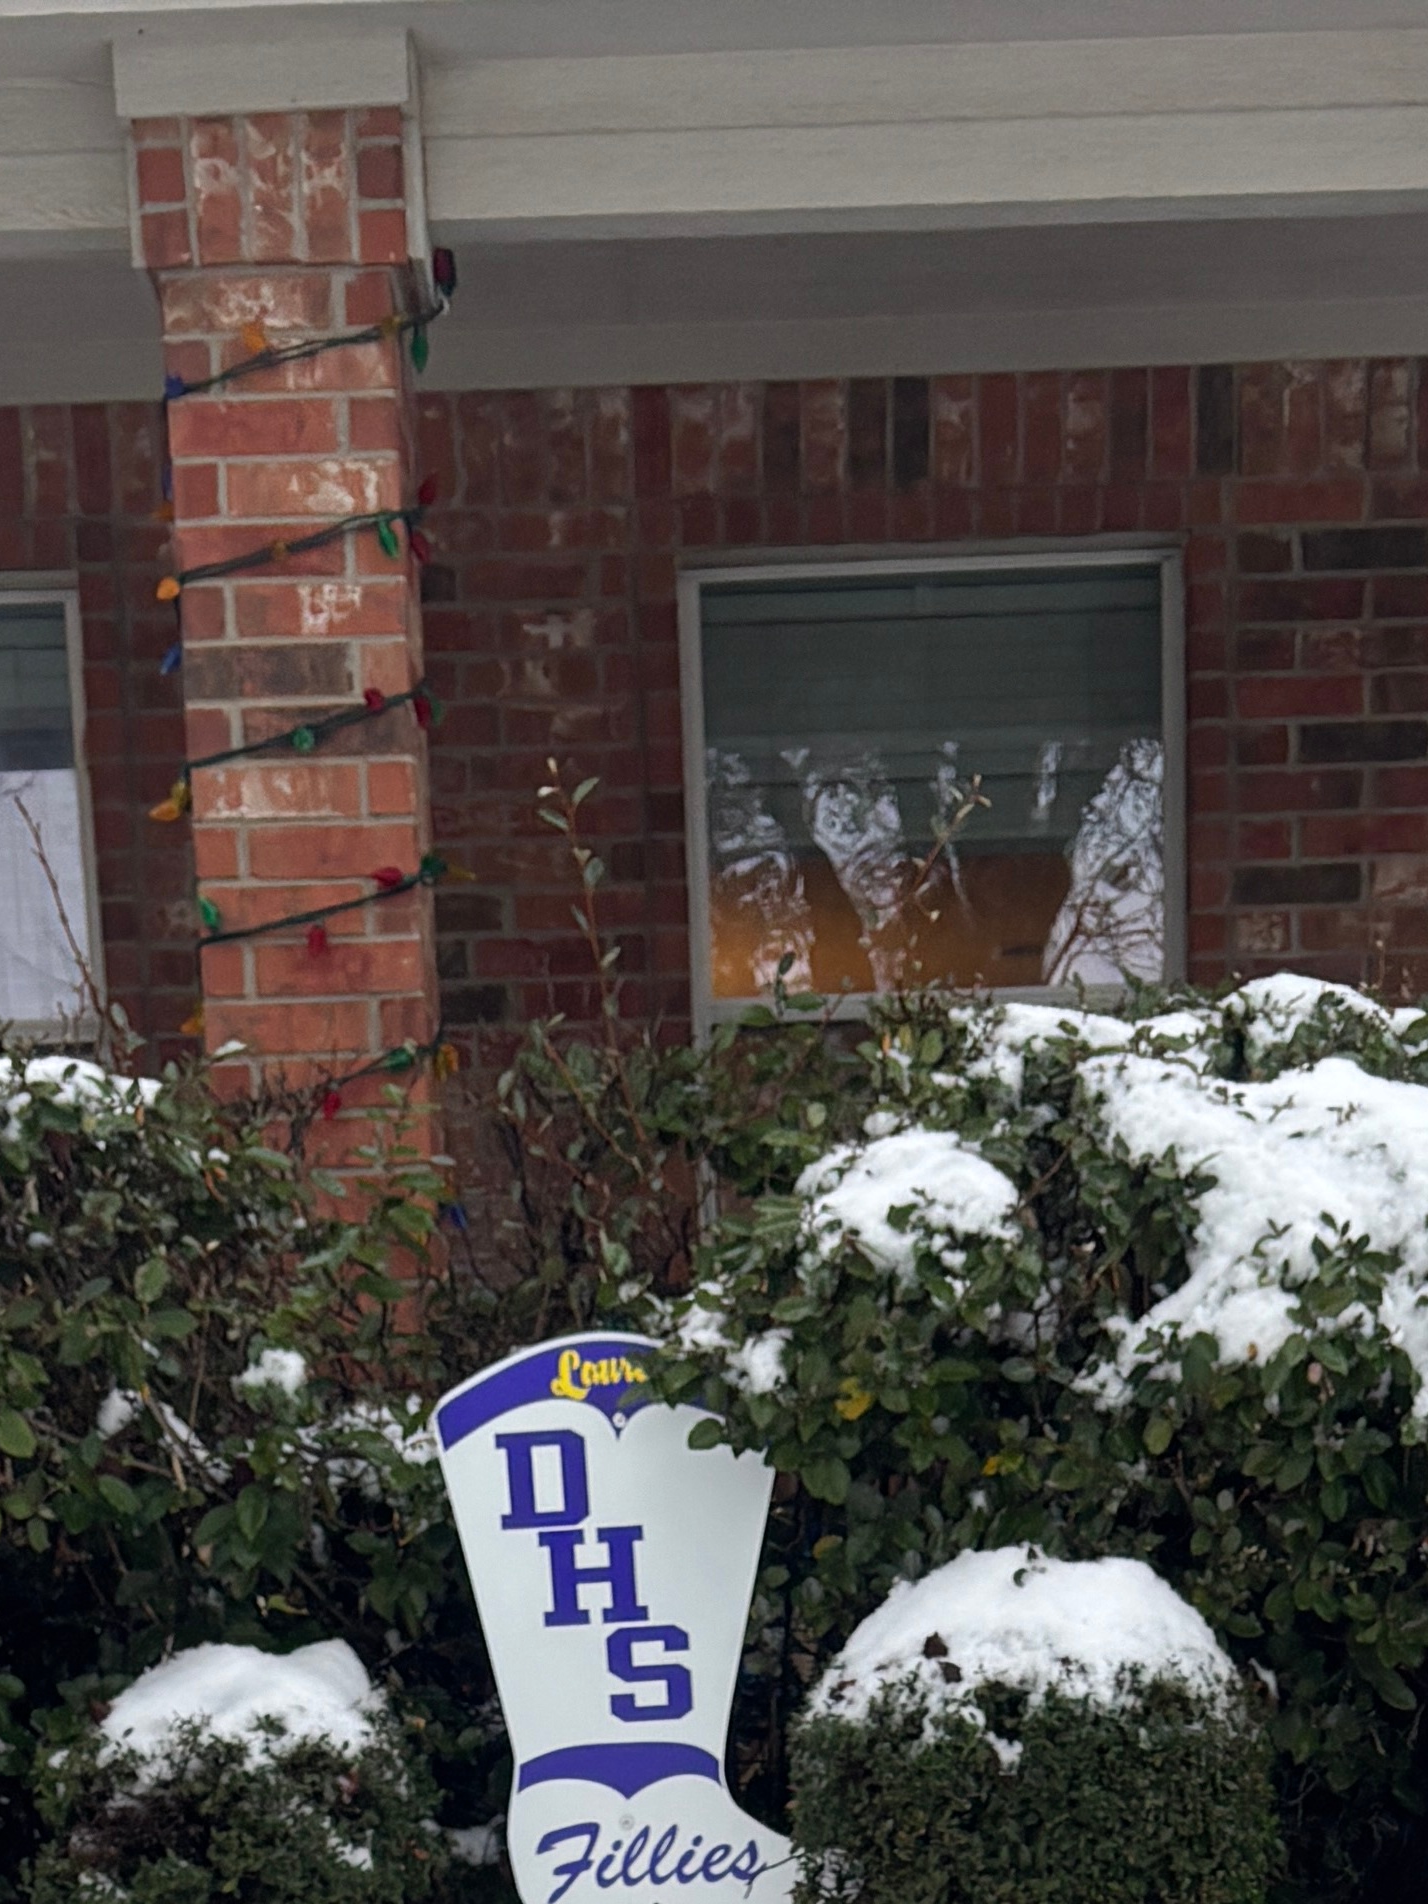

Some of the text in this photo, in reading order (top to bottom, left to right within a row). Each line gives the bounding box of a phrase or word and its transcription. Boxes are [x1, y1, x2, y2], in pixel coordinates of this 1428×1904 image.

[550, 1349, 649, 1401] Laur
[495, 1429, 693, 1722] DHS
[535, 1821, 759, 1904] Fillies
